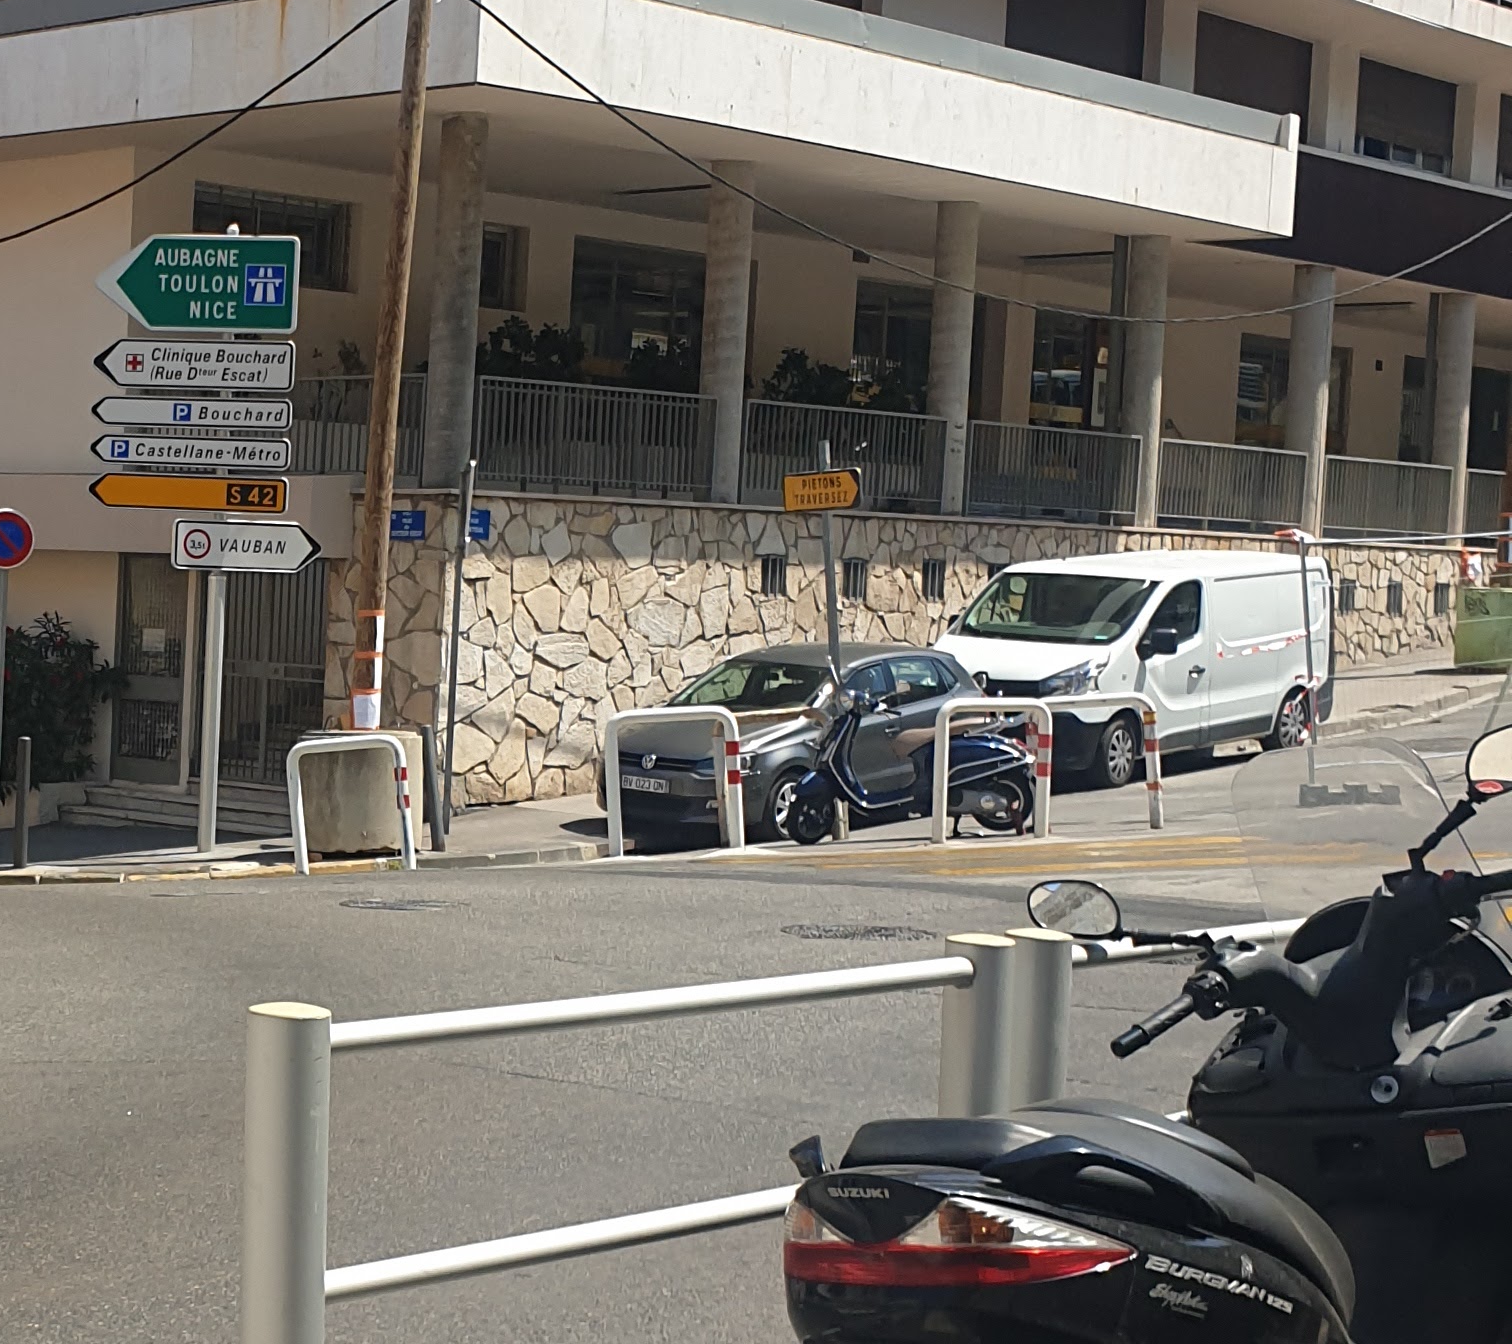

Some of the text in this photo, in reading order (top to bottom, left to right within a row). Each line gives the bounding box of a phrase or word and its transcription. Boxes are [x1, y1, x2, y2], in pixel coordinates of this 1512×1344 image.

[154, 248, 239, 267] AUBAGNE
[159, 274, 238, 293] TOULON
[189, 301, 237, 320] NICE
[151, 348, 287, 365] Clinique Bouchard
[150, 365, 182, 381] (Rue
[221, 367, 268, 383] Escat)
[176, 406, 284, 422] P Bouchard
[114, 442, 281, 461] P Castellane-Métro
[801, 477, 841, 490] PIETONS
[230, 487, 274, 505] S 42
[794, 491, 849, 505] TRAVERSEZ
[220, 538, 286, 555] VAUBAN
[827, 1187, 889, 1199] SUZUKI
[1144, 1253, 1266, 1302] BURGMAN
